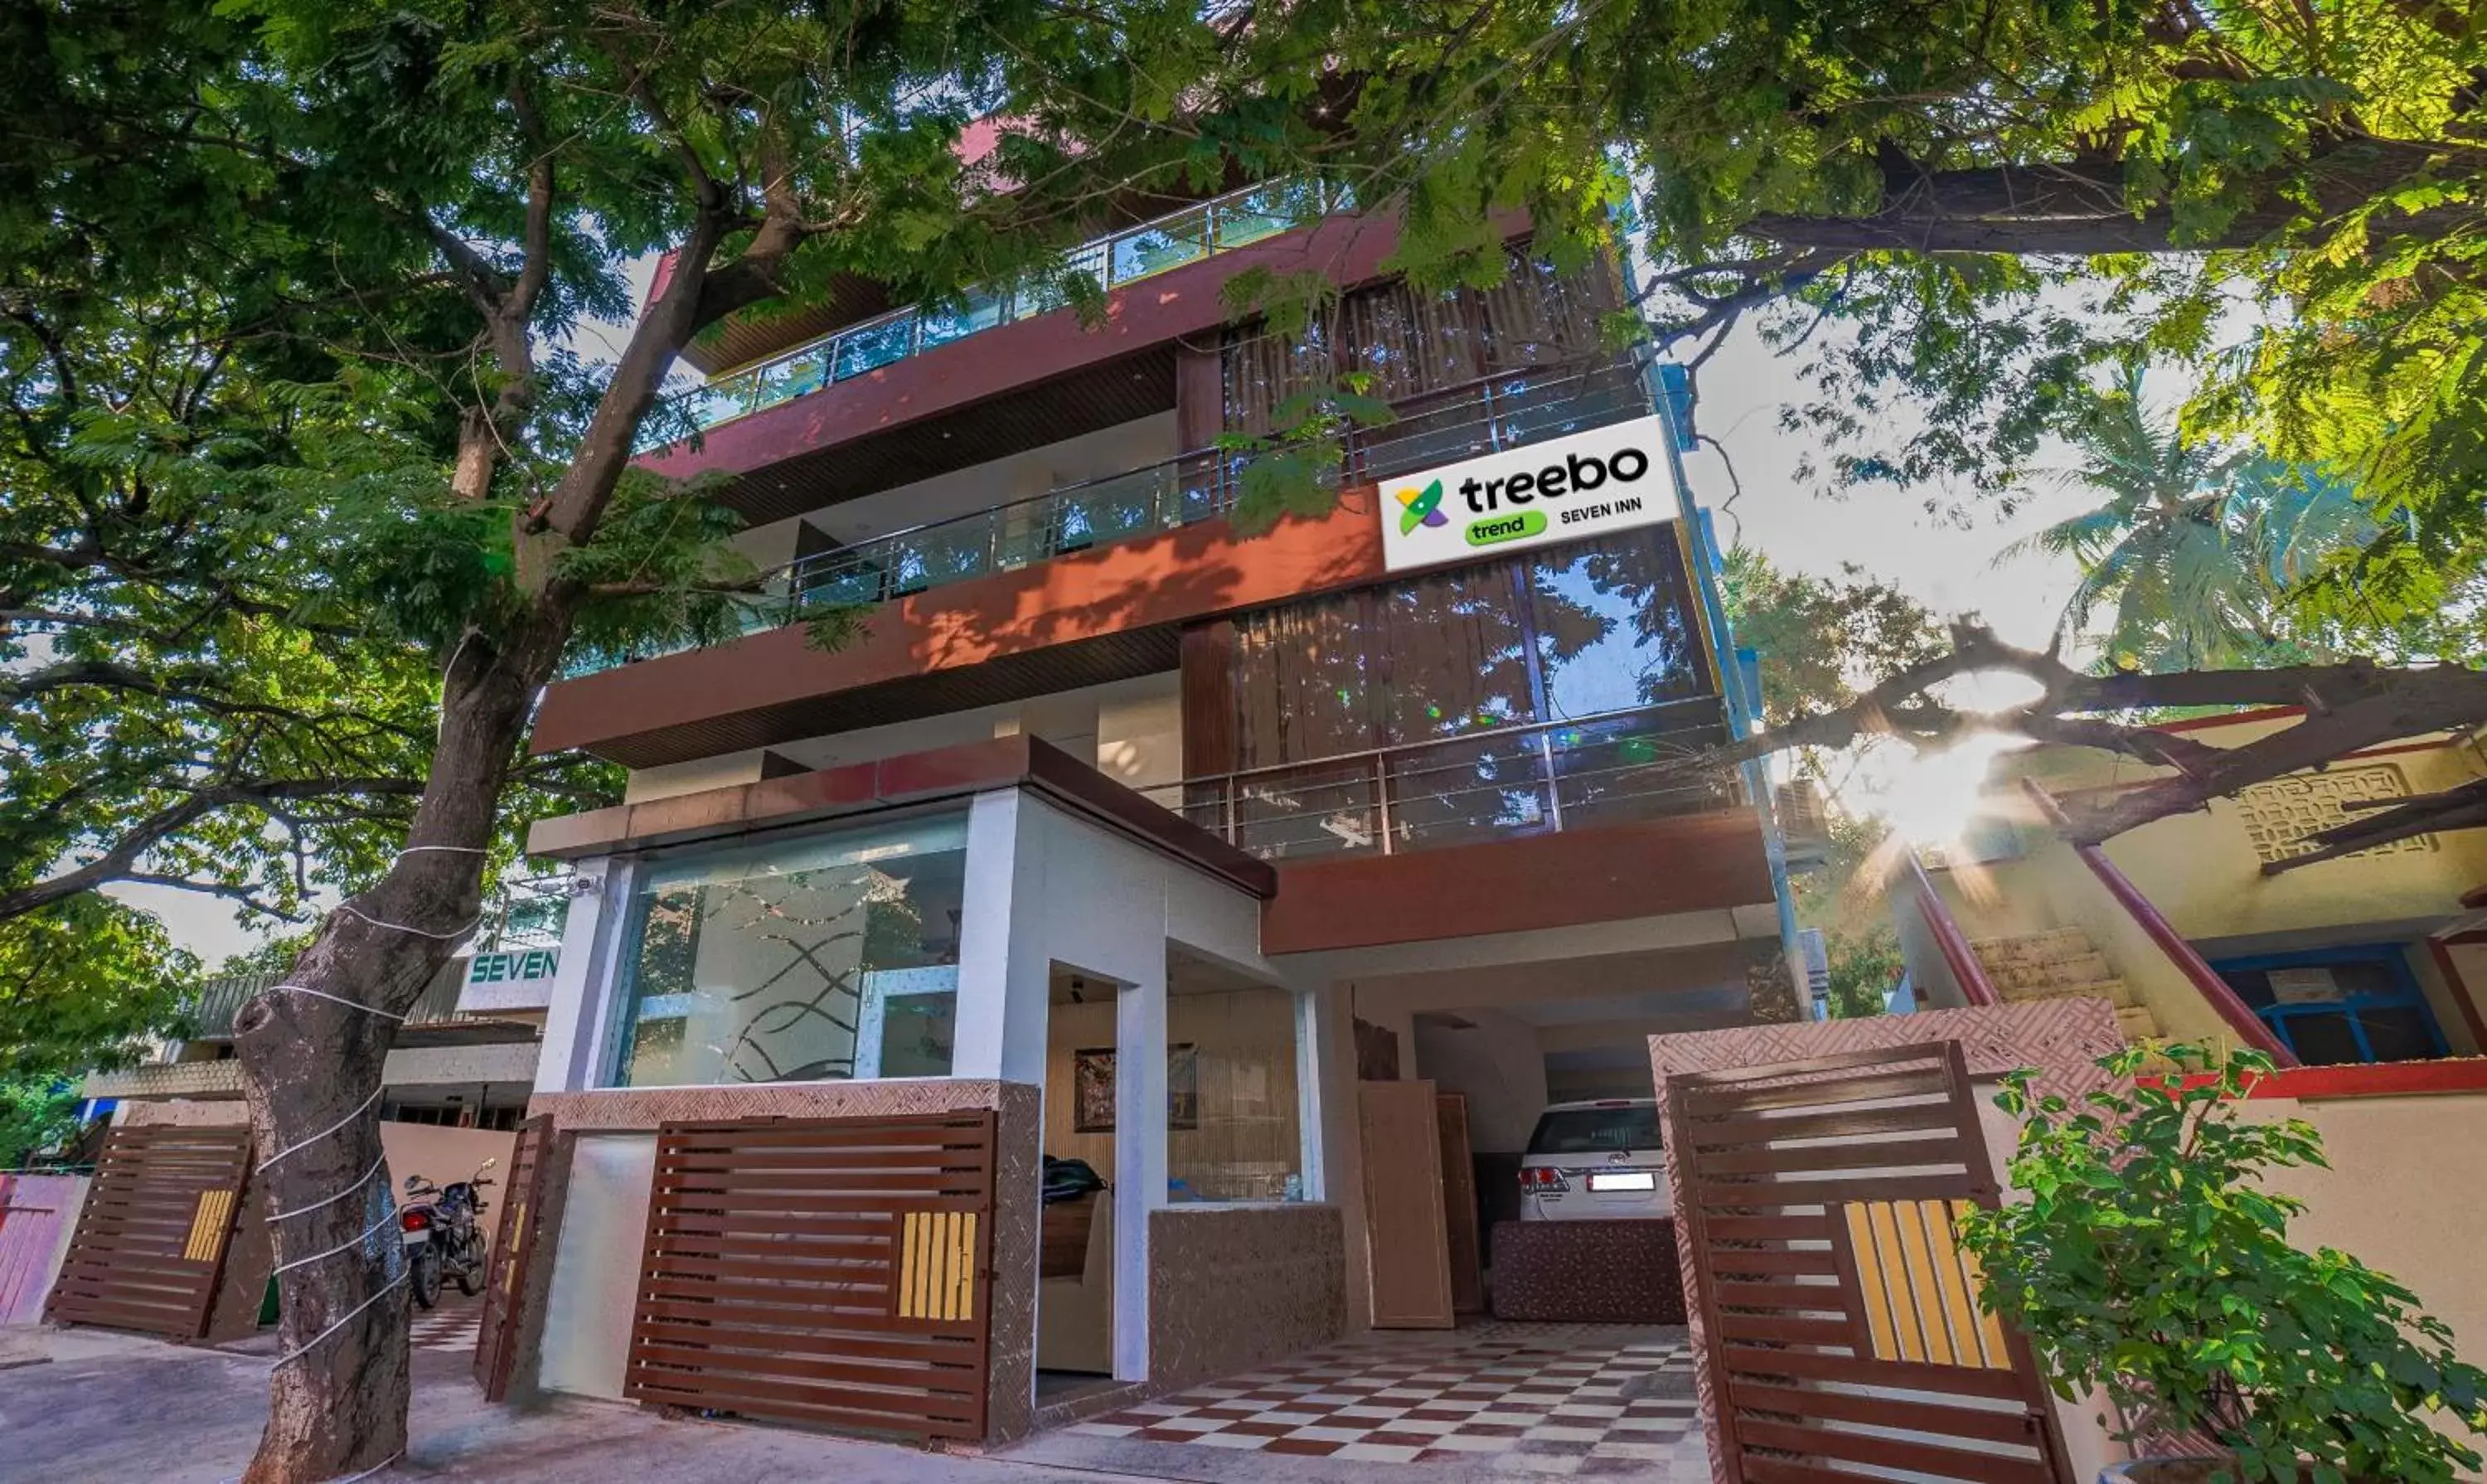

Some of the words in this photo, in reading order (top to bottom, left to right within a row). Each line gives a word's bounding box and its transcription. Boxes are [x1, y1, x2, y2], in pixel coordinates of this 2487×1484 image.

[1459, 447, 1648, 512] treebo
[1560, 502, 1612, 524] SEVEN
[1615, 497, 1642, 516] INN
[1471, 516, 1525, 540] trend
[470, 951, 560, 983] SEVEN
